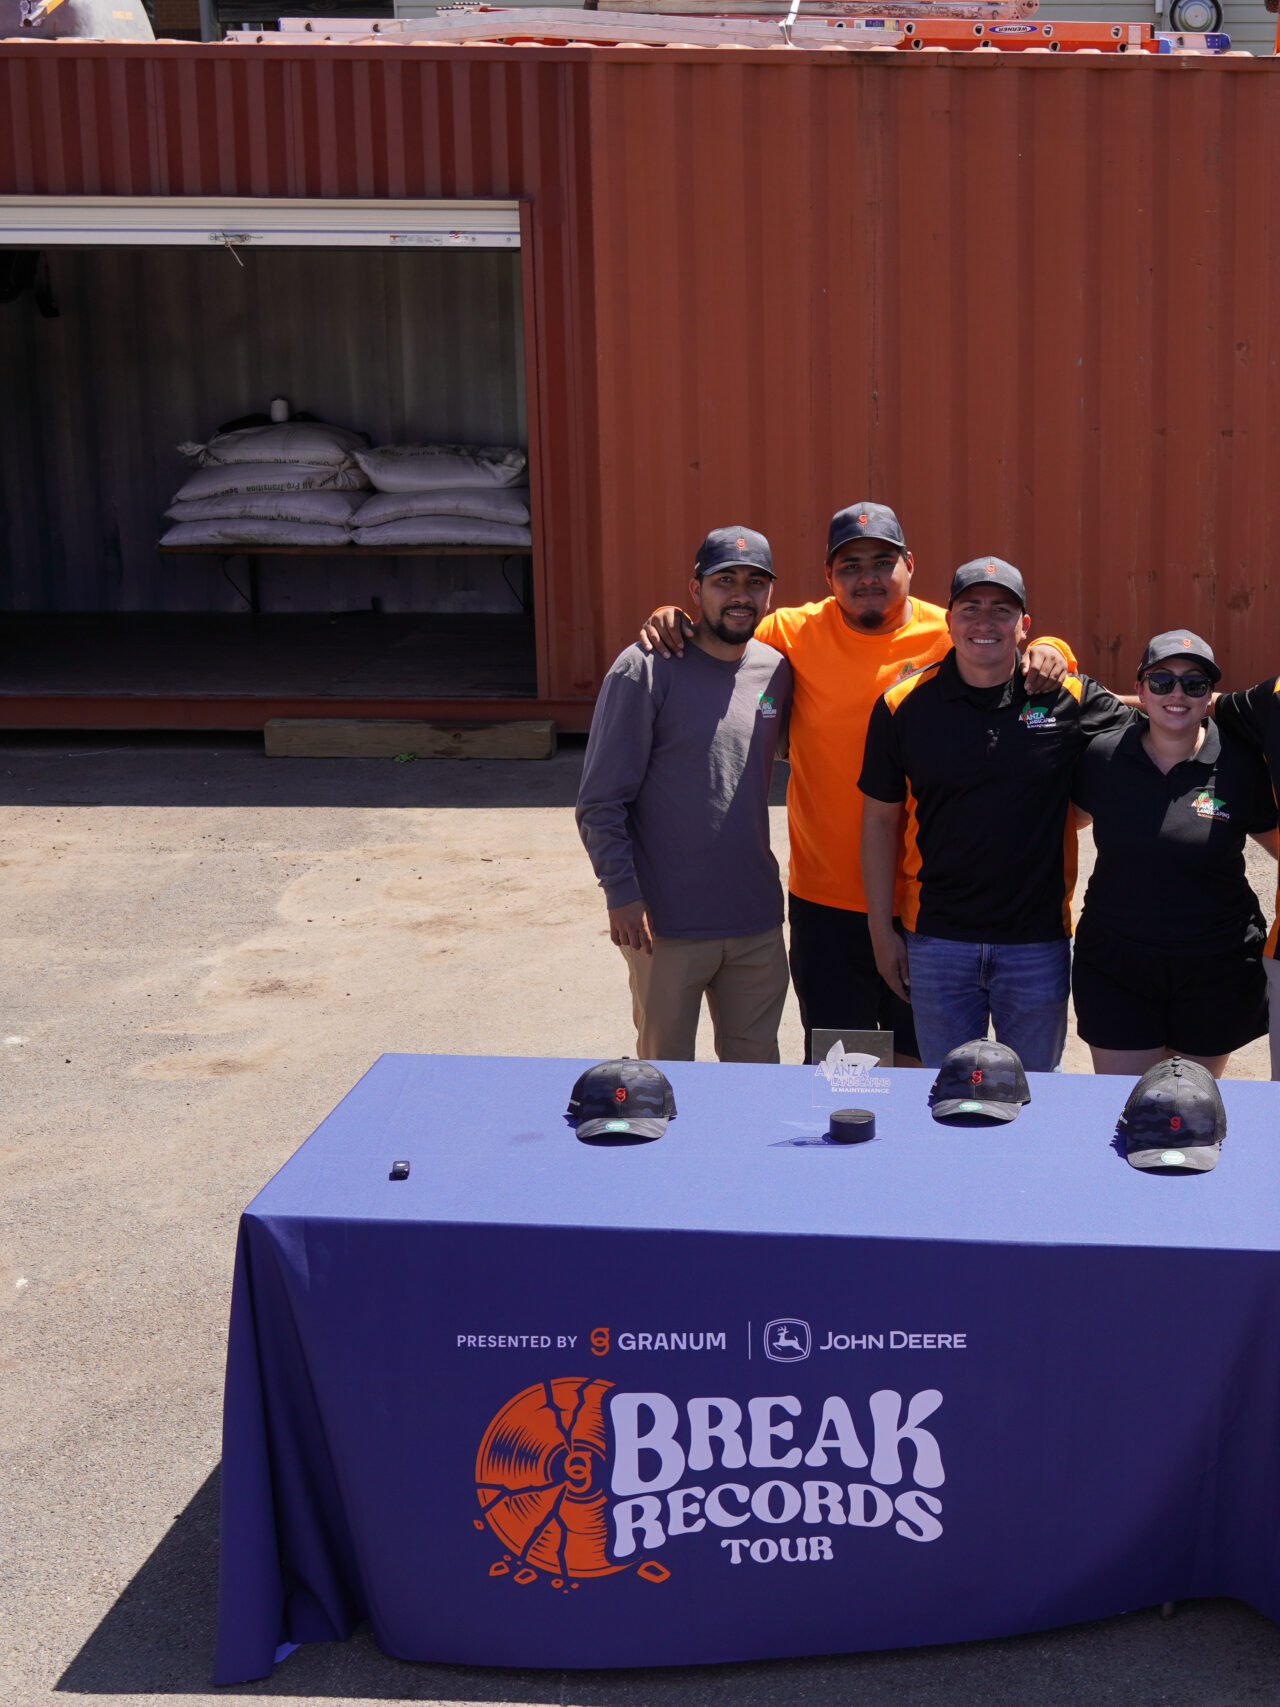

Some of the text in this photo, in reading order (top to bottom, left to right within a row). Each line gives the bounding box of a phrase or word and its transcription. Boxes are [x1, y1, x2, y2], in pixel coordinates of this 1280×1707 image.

[830, 1077, 892, 1088] LANDSCAPING
[457, 1335, 551, 1348] PRESENTED
[557, 1335, 578, 1348] BY
[617, 1332, 726, 1350] GRANUM
[819, 1330, 967, 1350] JOHN DEERE
[610, 1389, 946, 1496] BREAK
[612, 1480, 944, 1558] RECORDS
[720, 1536, 834, 1565] TOUR
